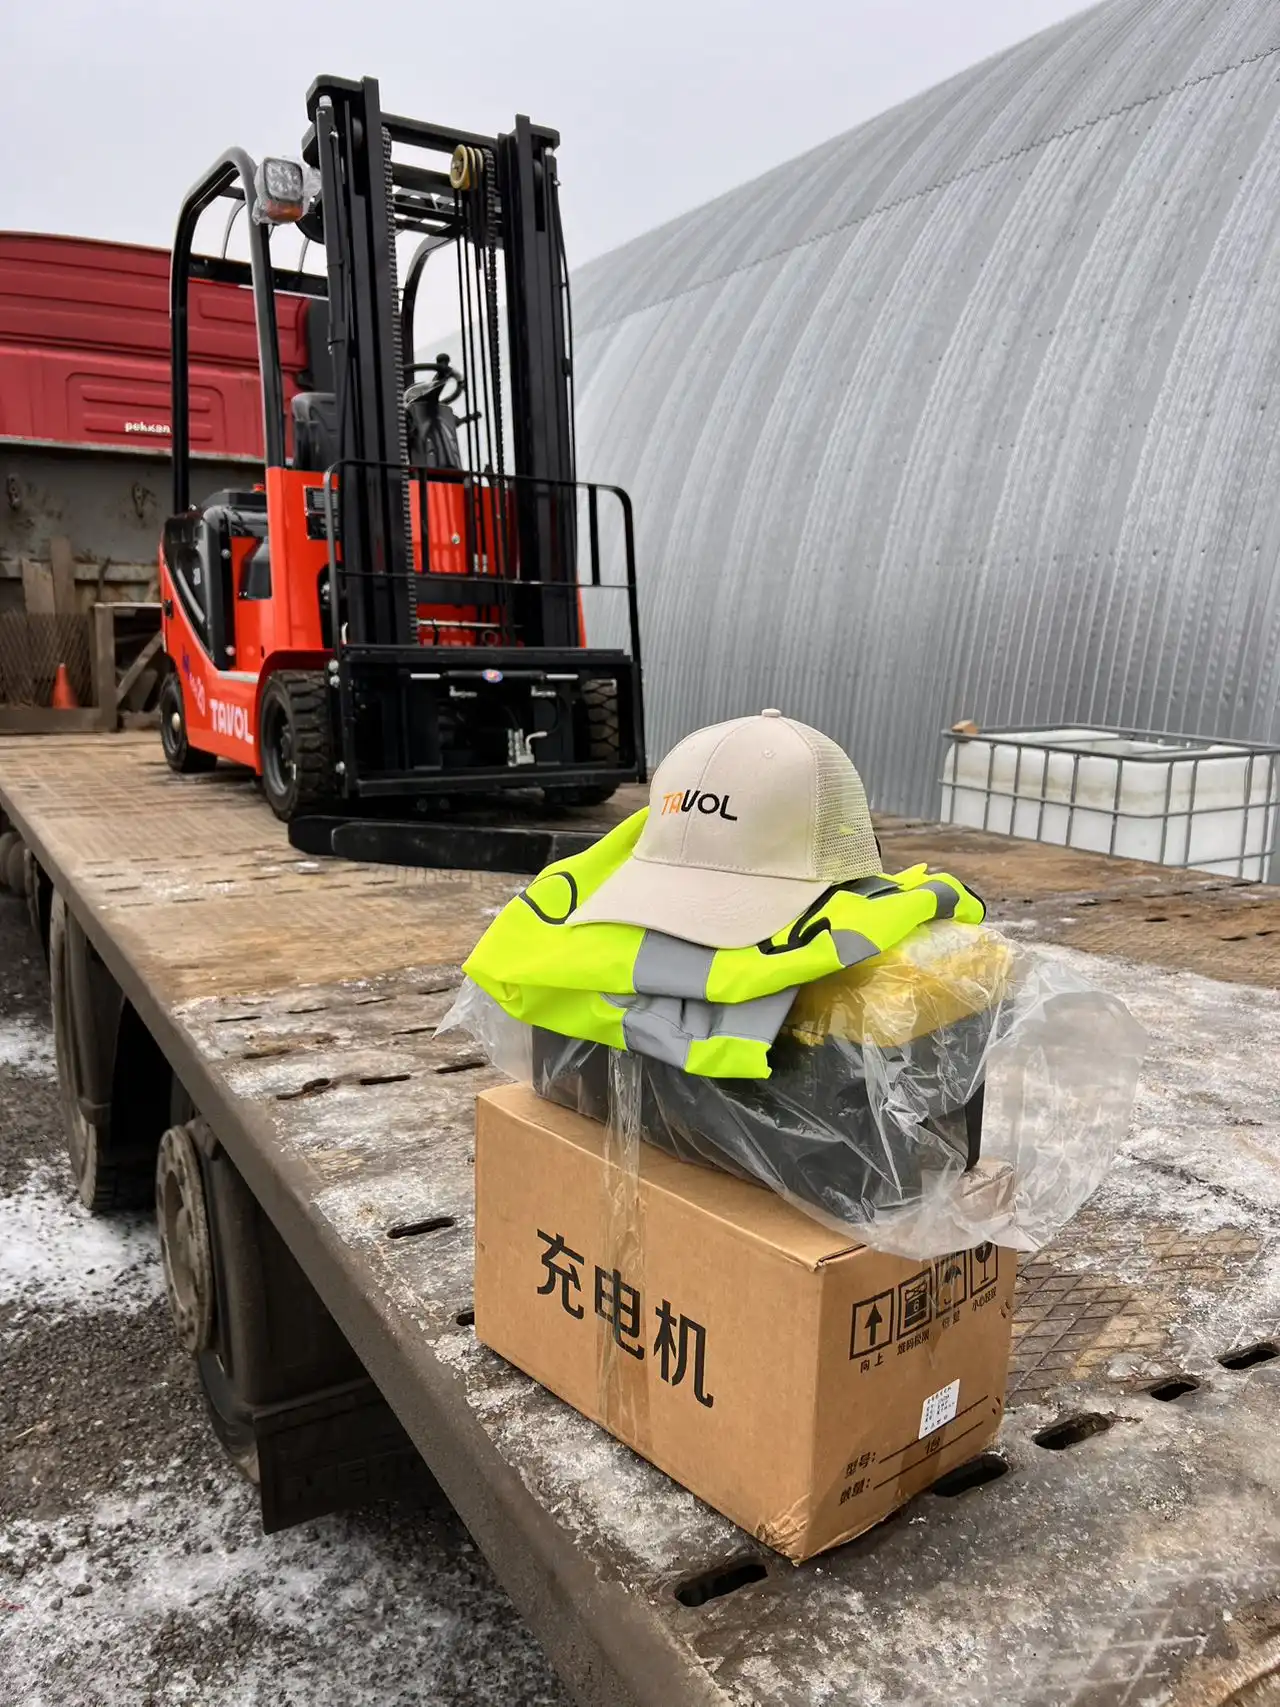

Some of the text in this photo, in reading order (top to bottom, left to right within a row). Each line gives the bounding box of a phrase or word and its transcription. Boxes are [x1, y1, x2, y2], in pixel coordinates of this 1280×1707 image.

[209, 699, 254, 745] TAVOL
[661, 789, 738, 821] TAVOL
[537, 1228, 714, 1408] 充电机
[860, 1352, 884, 1373] 向上
